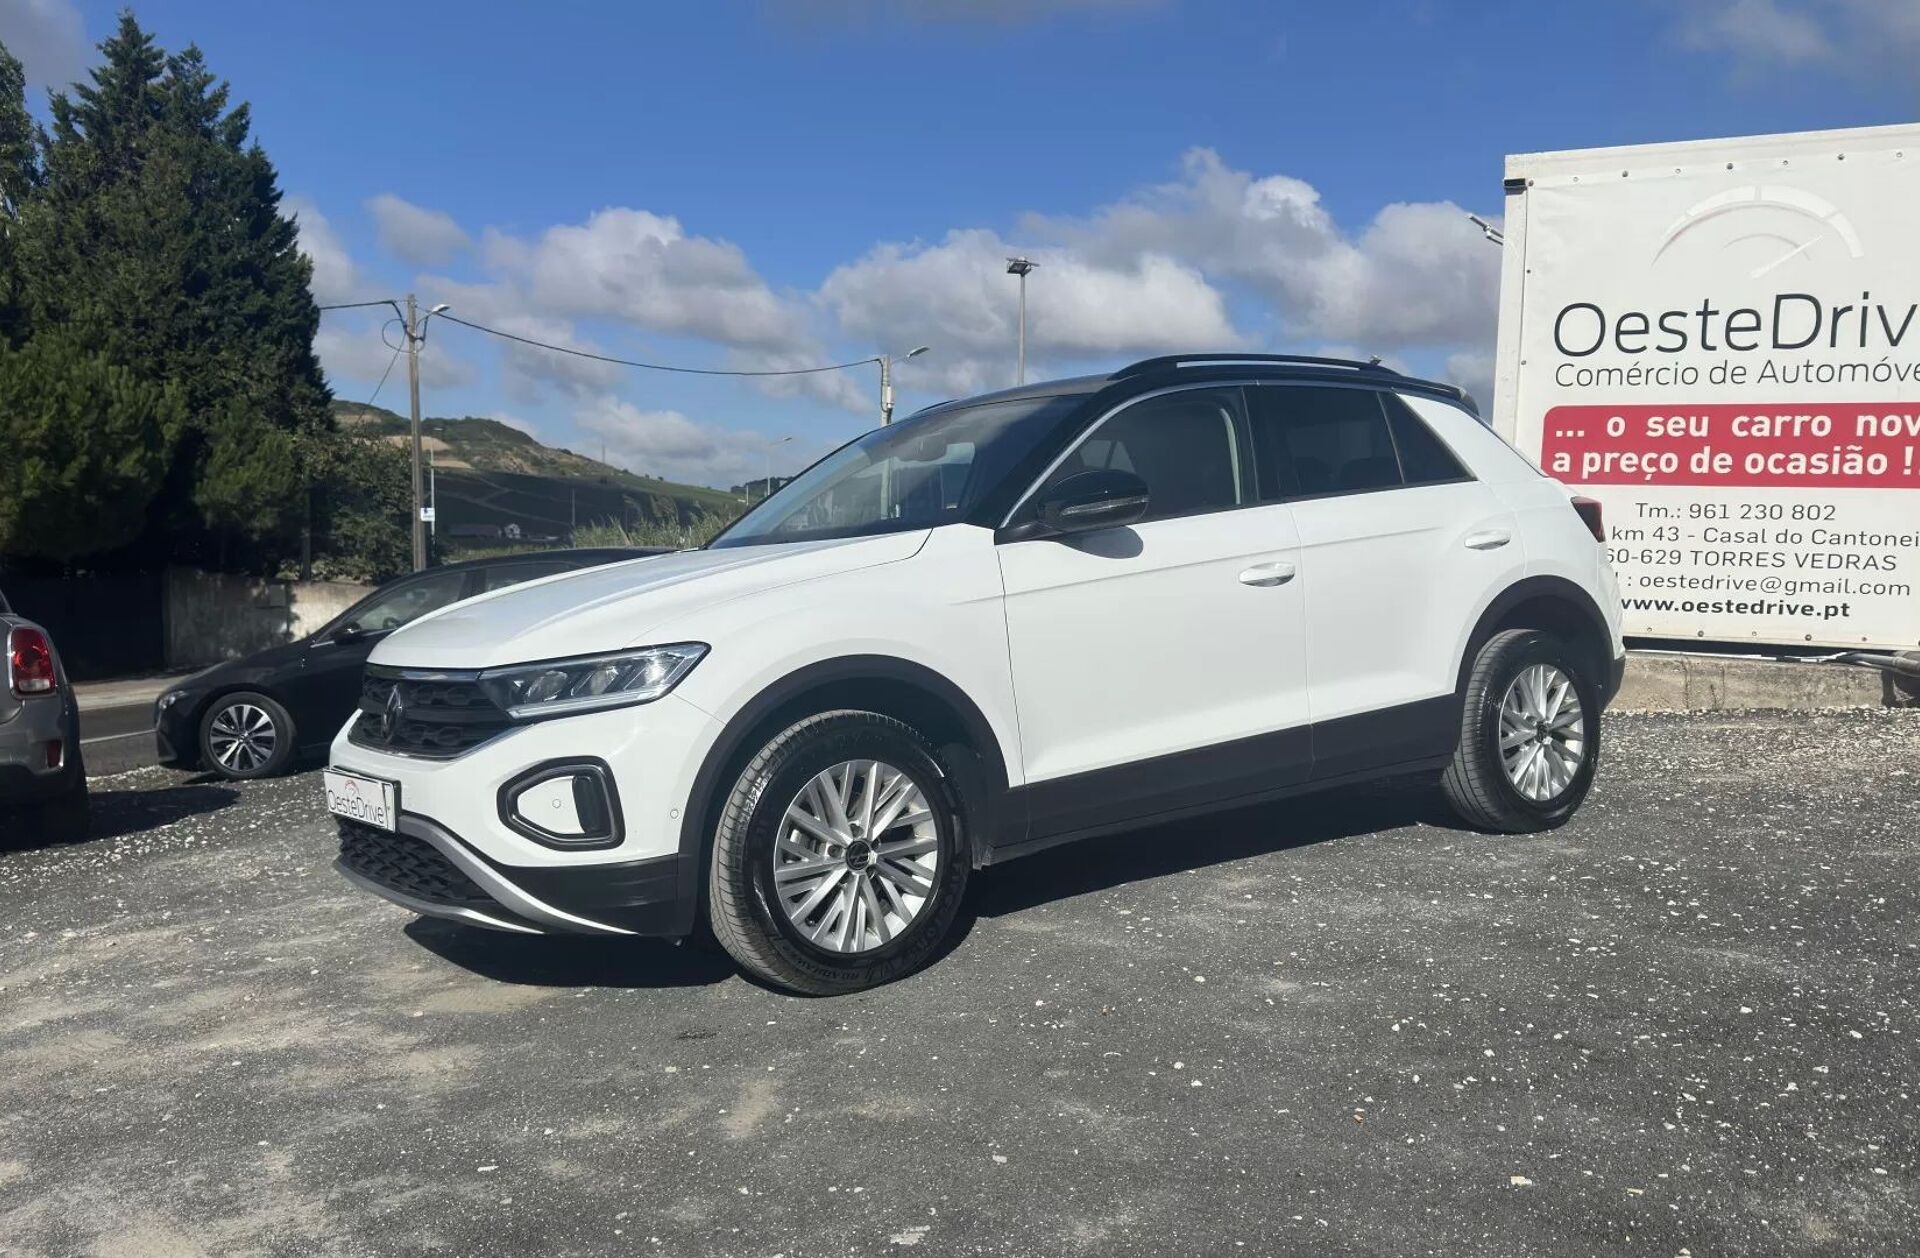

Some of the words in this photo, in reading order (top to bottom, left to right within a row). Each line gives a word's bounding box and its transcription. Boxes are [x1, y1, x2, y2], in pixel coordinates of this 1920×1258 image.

[1553, 290, 1918, 357] OesteDriv
[1554, 360, 1700, 388] Comércio
[1708, 359, 1748, 385] de
[1606, 415, 1626, 438] o
[1645, 415, 1709, 438] seu
[1731, 414, 1832, 438] carro
[1856, 414, 1920, 437] nov
[1552, 450, 1571, 474] a
[1581, 448, 1679, 481] preço
[1690, 446, 1733, 475] de
[1744, 444, 1888, 475] ocasião
[1635, 502, 1681, 518] Tm.:
[1689, 503, 1731, 520] 961
[1740, 504, 1784, 520] 230
[1791, 504, 1836, 521] 802
[1612, 526, 1644, 541] km
[1652, 526, 1680, 541] 43
[1703, 527, 1767, 544] Casal
[1775, 529, 1803, 545] do
[1811, 529, 1919, 547] Cantonei
[1690, 550, 1786, 568] TORRES
[1794, 553, 1897, 571] VEDRAS
[1639, 574, 1911, 596] oestedrive@gmail.com
[328, 789, 384, 824] OesteDrive
